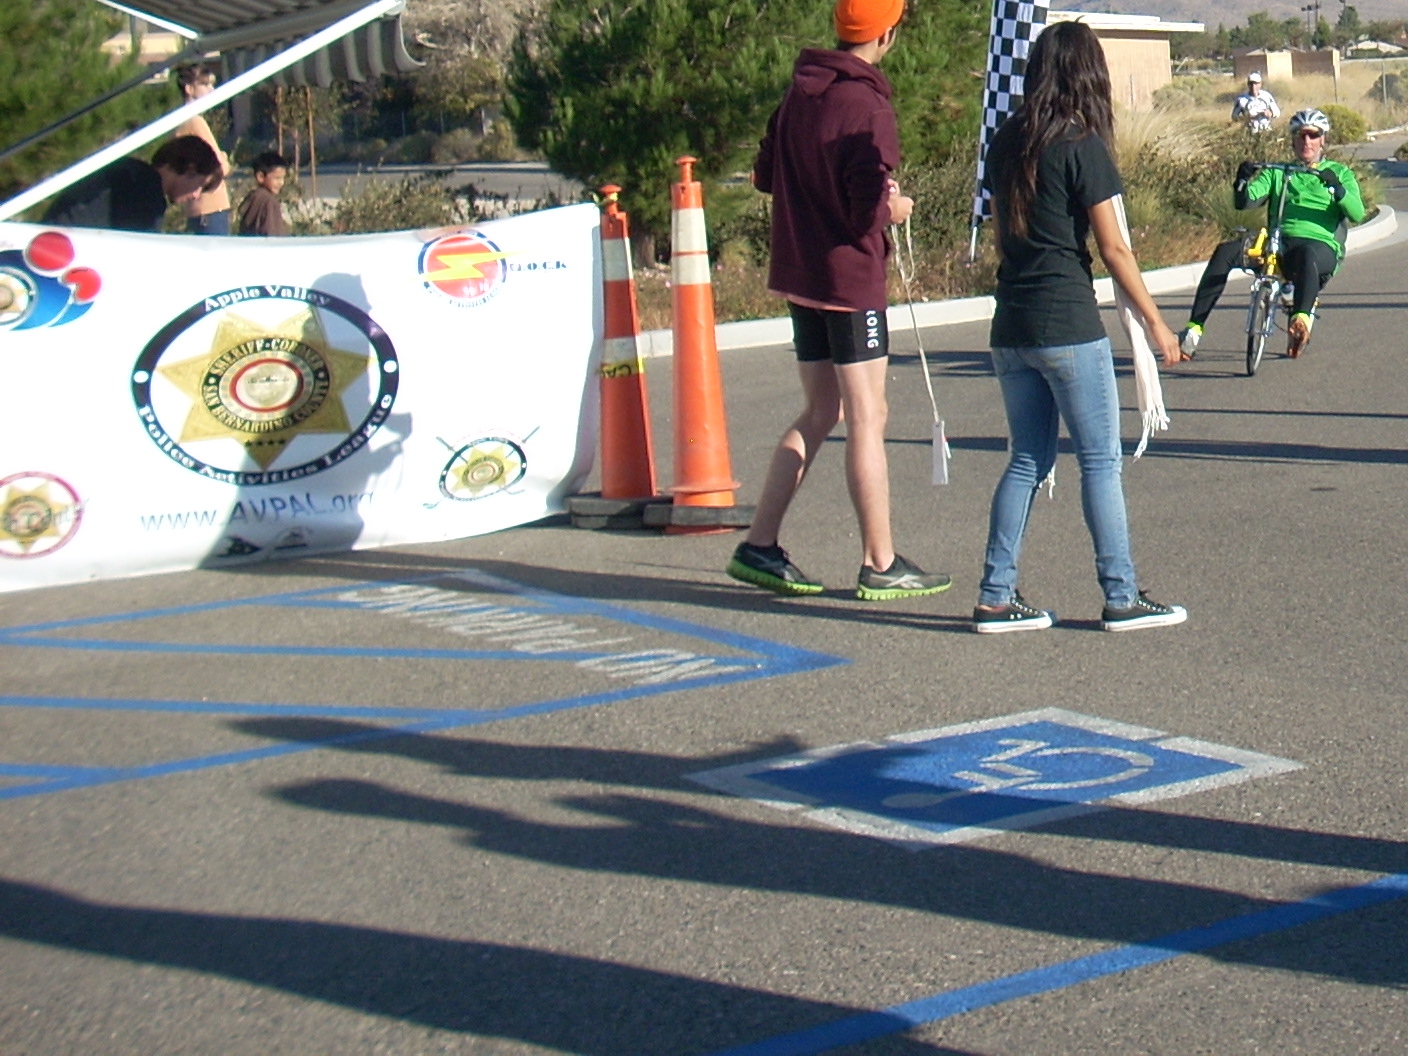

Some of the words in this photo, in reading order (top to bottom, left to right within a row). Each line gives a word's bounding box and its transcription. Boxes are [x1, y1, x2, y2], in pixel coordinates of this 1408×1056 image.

[204, 286, 260, 311] Apple
[264, 284, 331, 306] Valley
[138, 405, 196, 469] Police
[200, 463, 319, 486] Activities
[322, 394, 393, 468] League
